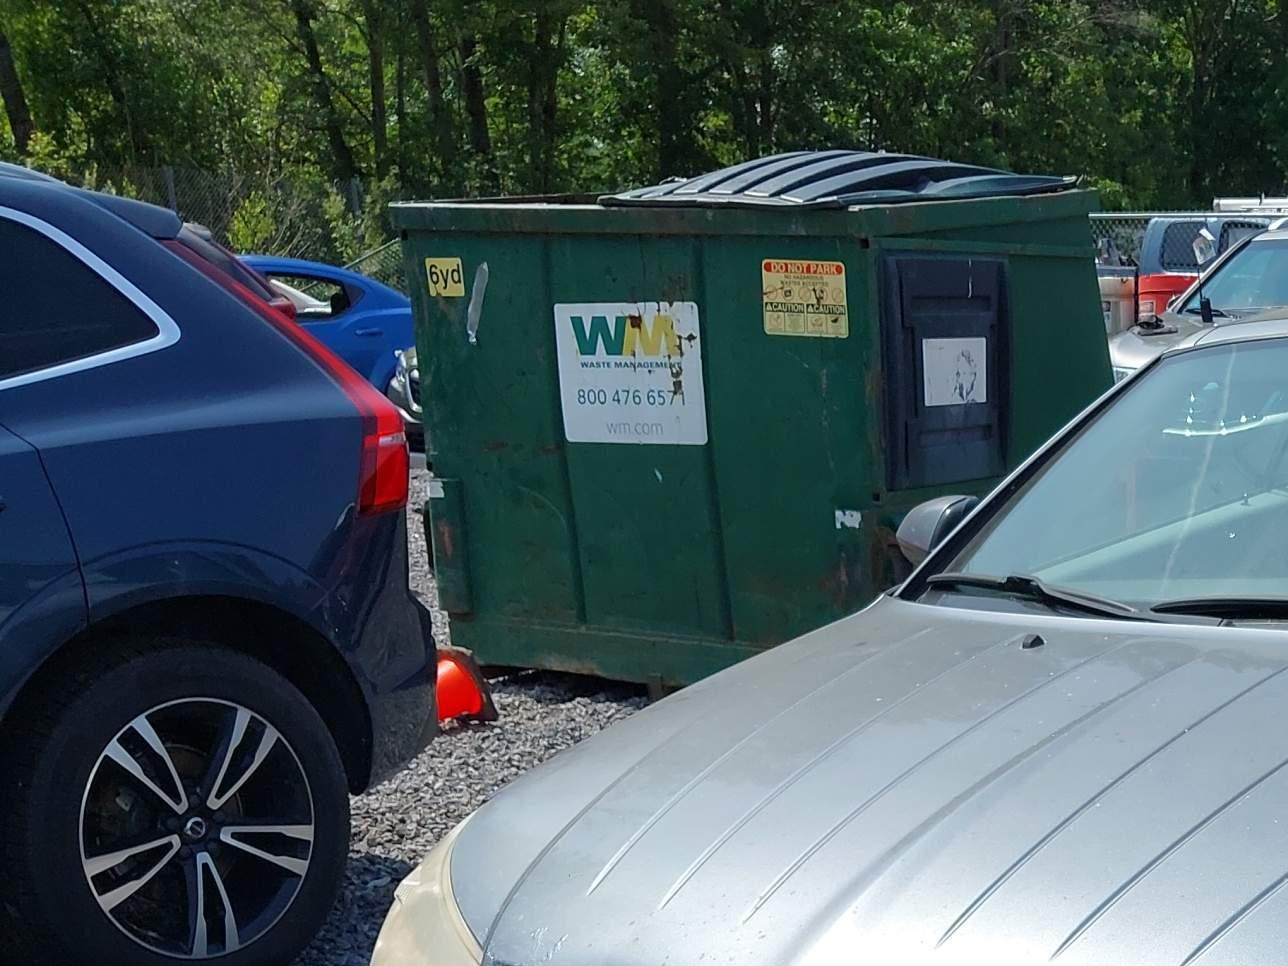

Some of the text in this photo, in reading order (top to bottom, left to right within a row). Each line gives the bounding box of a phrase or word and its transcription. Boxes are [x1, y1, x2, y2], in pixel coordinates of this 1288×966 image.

[771, 262, 837, 275] DO NOT PARK
[429, 264, 461, 289] 6yd
[772, 304, 804, 313] CAUTION
[814, 305, 845, 314] CAUTION
[570, 316, 681, 357] WM
[580, 361, 682, 370] WASTE MANAGEMENT
[577, 389, 607, 406] 800
[612, 389, 642, 406] 476
[606, 421, 664, 436] wm.com
